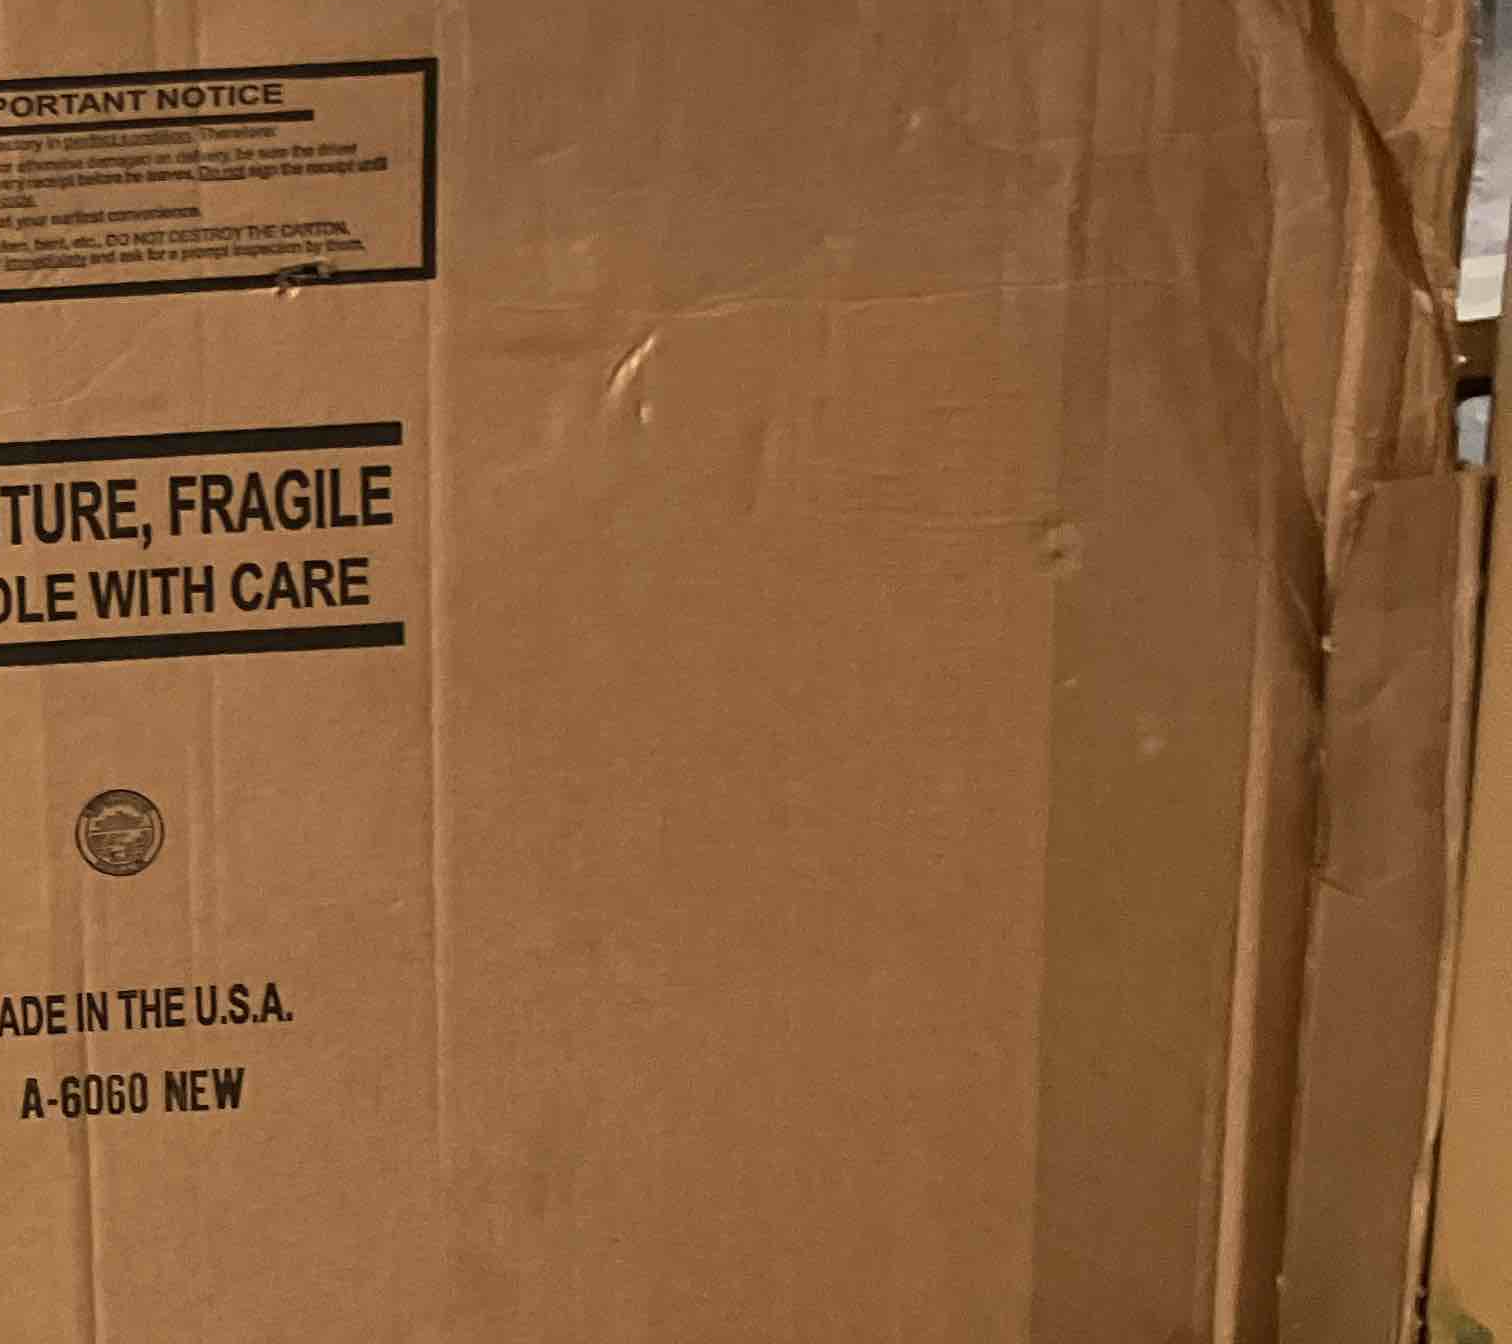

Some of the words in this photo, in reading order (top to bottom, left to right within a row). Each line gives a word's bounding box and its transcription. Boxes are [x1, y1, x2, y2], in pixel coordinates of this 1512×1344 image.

[157, 83, 283, 108] NOTICE
[133, 231, 165, 246] NOT
[168, 225, 243, 243] DESTROY
[247, 224, 277, 239] THE
[167, 465, 394, 537] FRAGILE
[90, 563, 214, 619] WITH
[229, 556, 371, 612] CARE
[77, 990, 108, 1033] IN
[118, 986, 185, 1031] THE
[195, 981, 294, 1027] U.S.A.
[20, 1071, 148, 1120] A-6060
[164, 1066, 246, 1113] NEW
